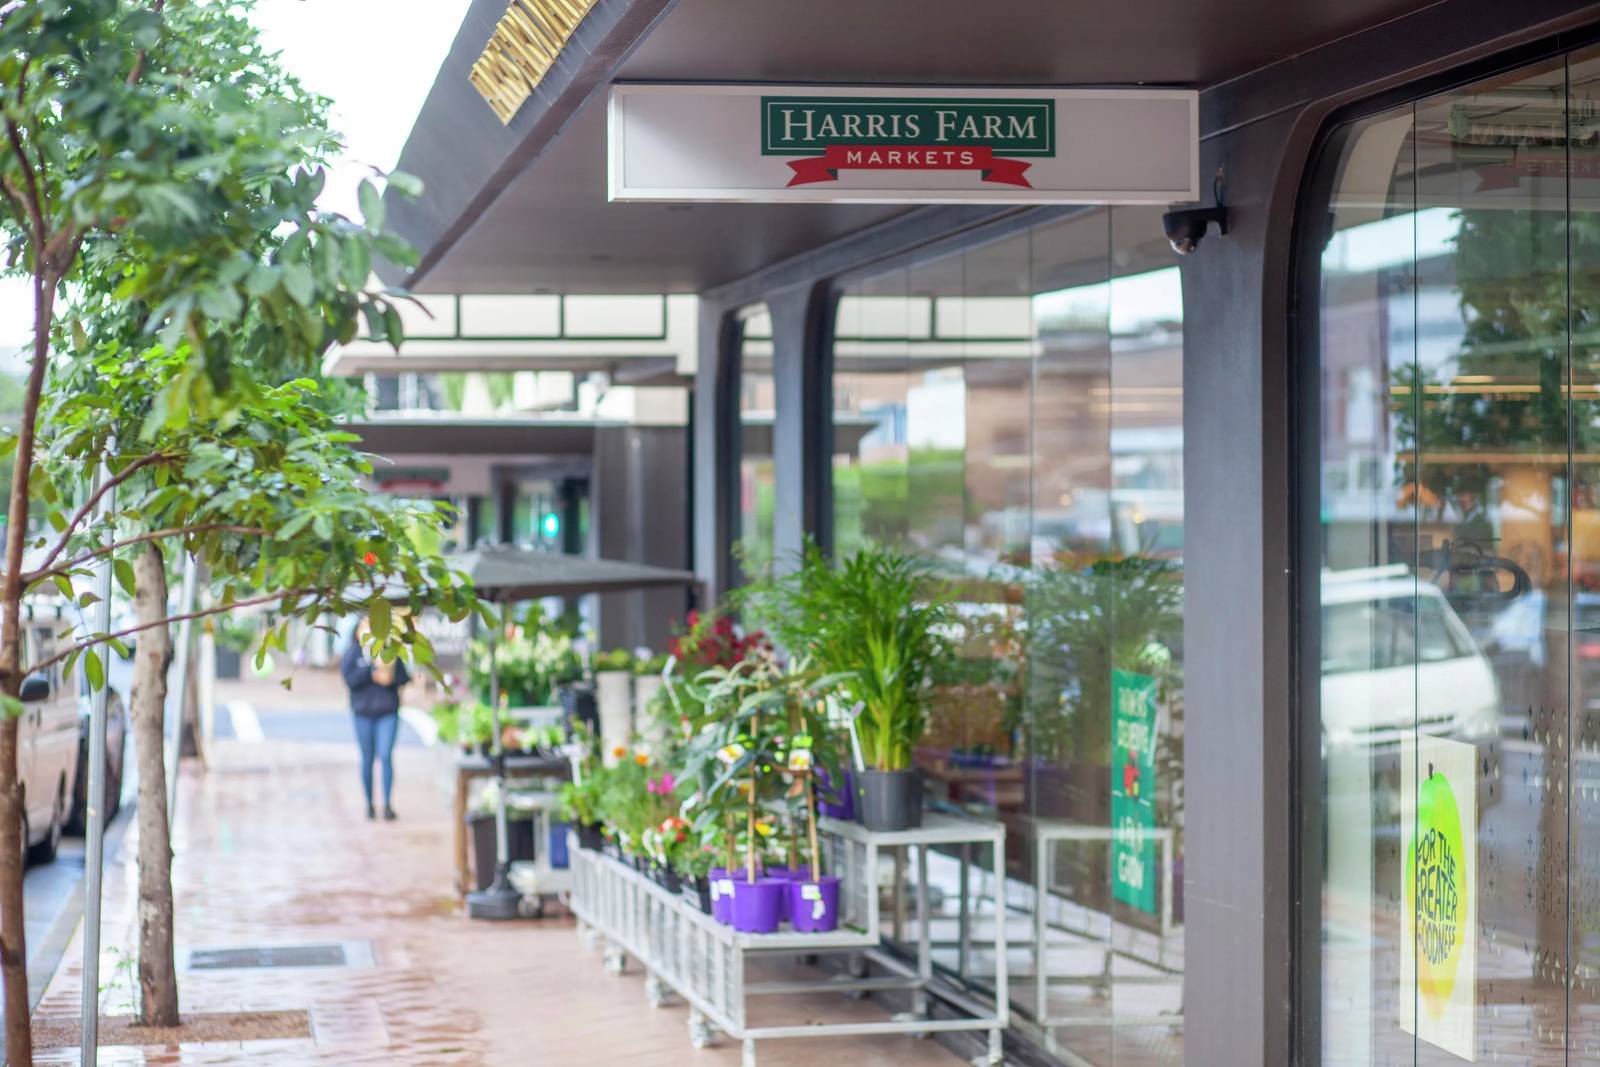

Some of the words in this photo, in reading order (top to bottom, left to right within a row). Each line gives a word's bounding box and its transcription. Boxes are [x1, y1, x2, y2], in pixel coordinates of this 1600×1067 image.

[780, 109, 921, 141] HARRIS
[934, 110, 1038, 142] FARM
[846, 150, 975, 166] MARKETS
[1438, 830, 1456, 889] THE
